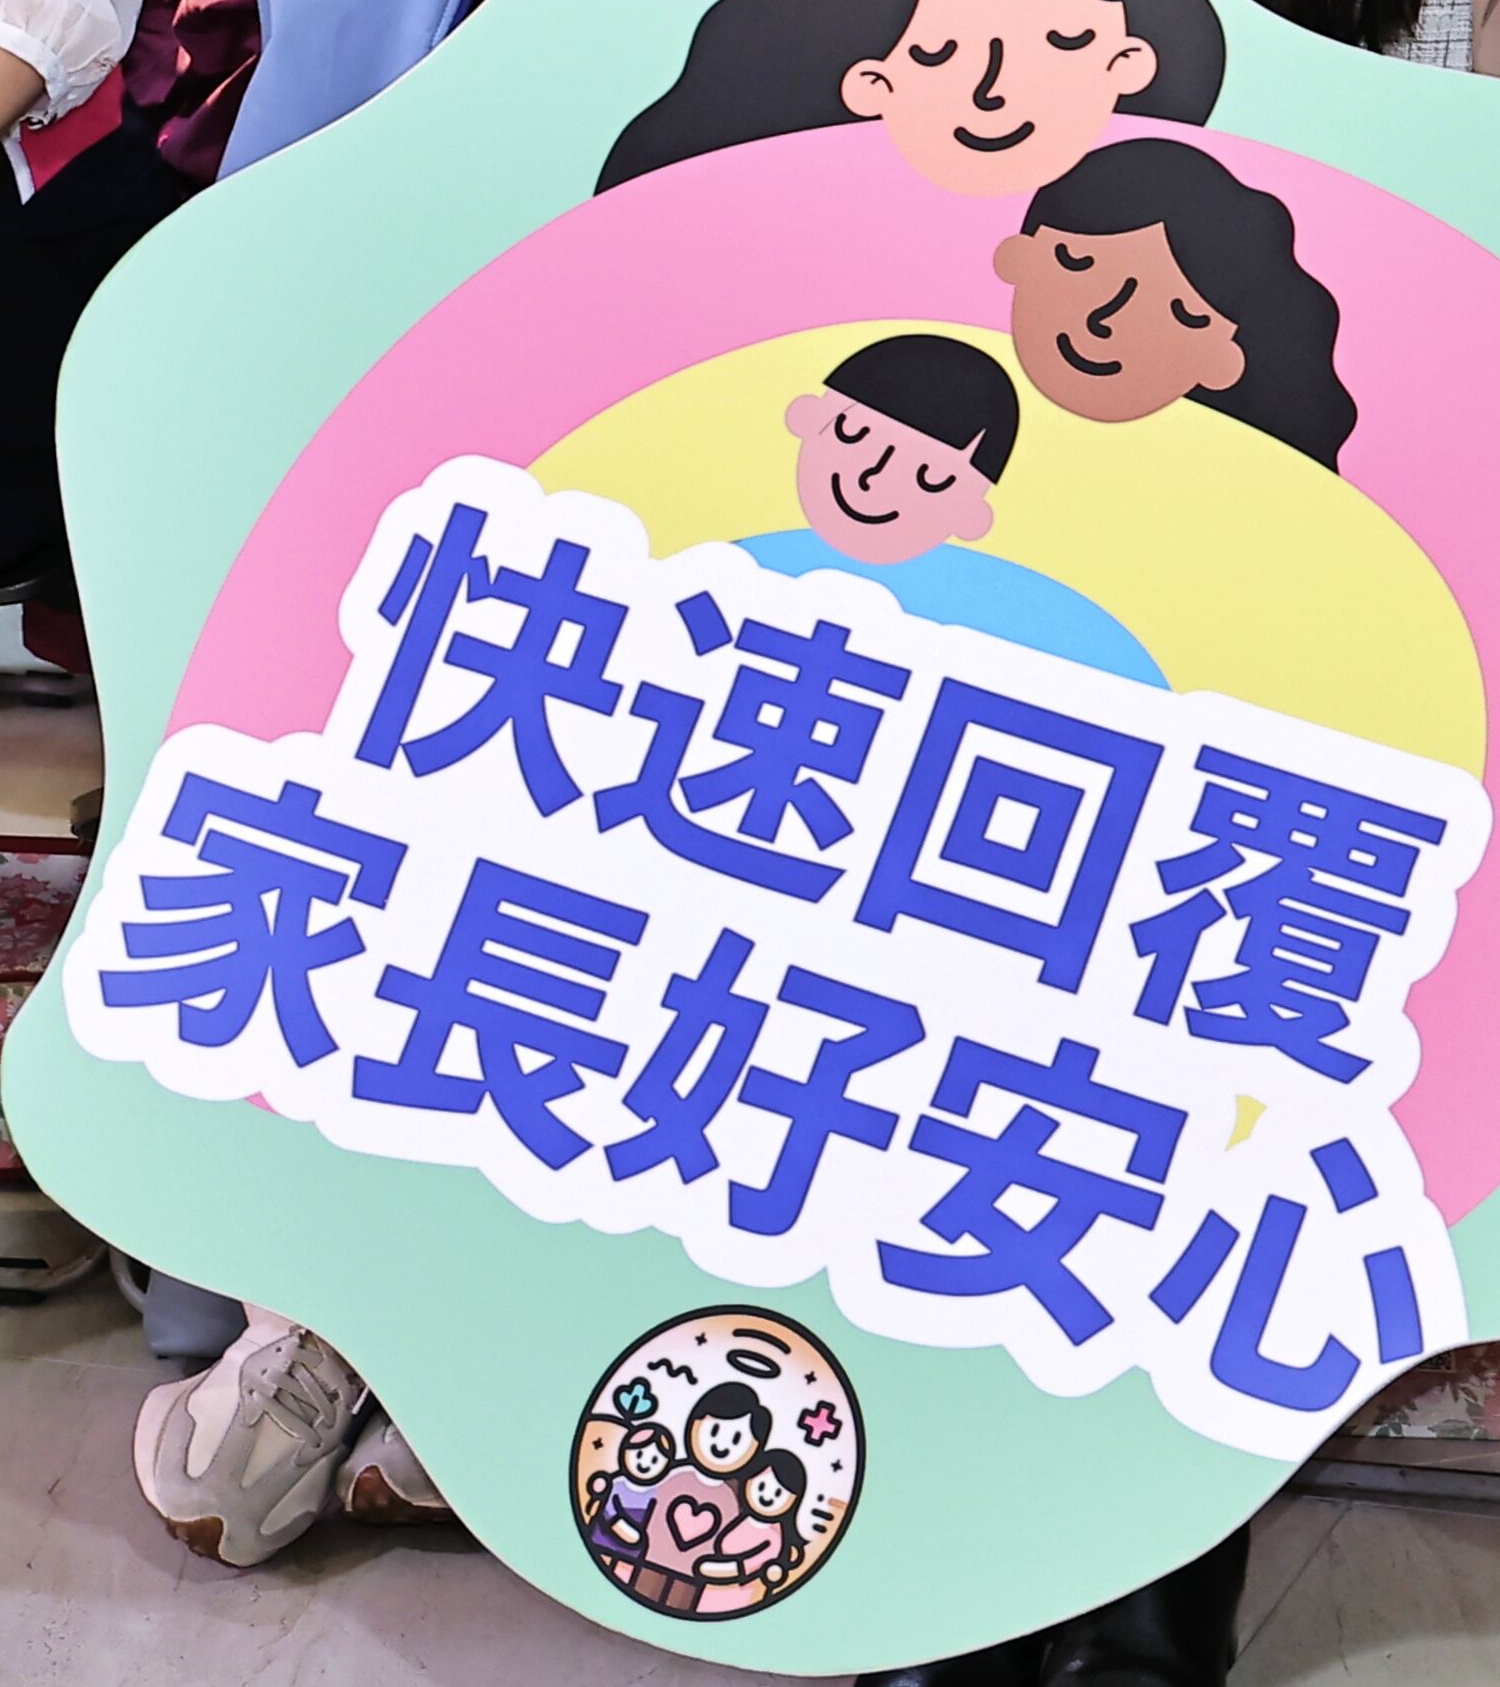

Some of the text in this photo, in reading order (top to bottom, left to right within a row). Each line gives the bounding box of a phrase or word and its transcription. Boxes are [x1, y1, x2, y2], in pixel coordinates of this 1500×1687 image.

[97, 771, 1425, 1413] 家長好安心
[354, 501, 1448, 1085] 快速回覆
